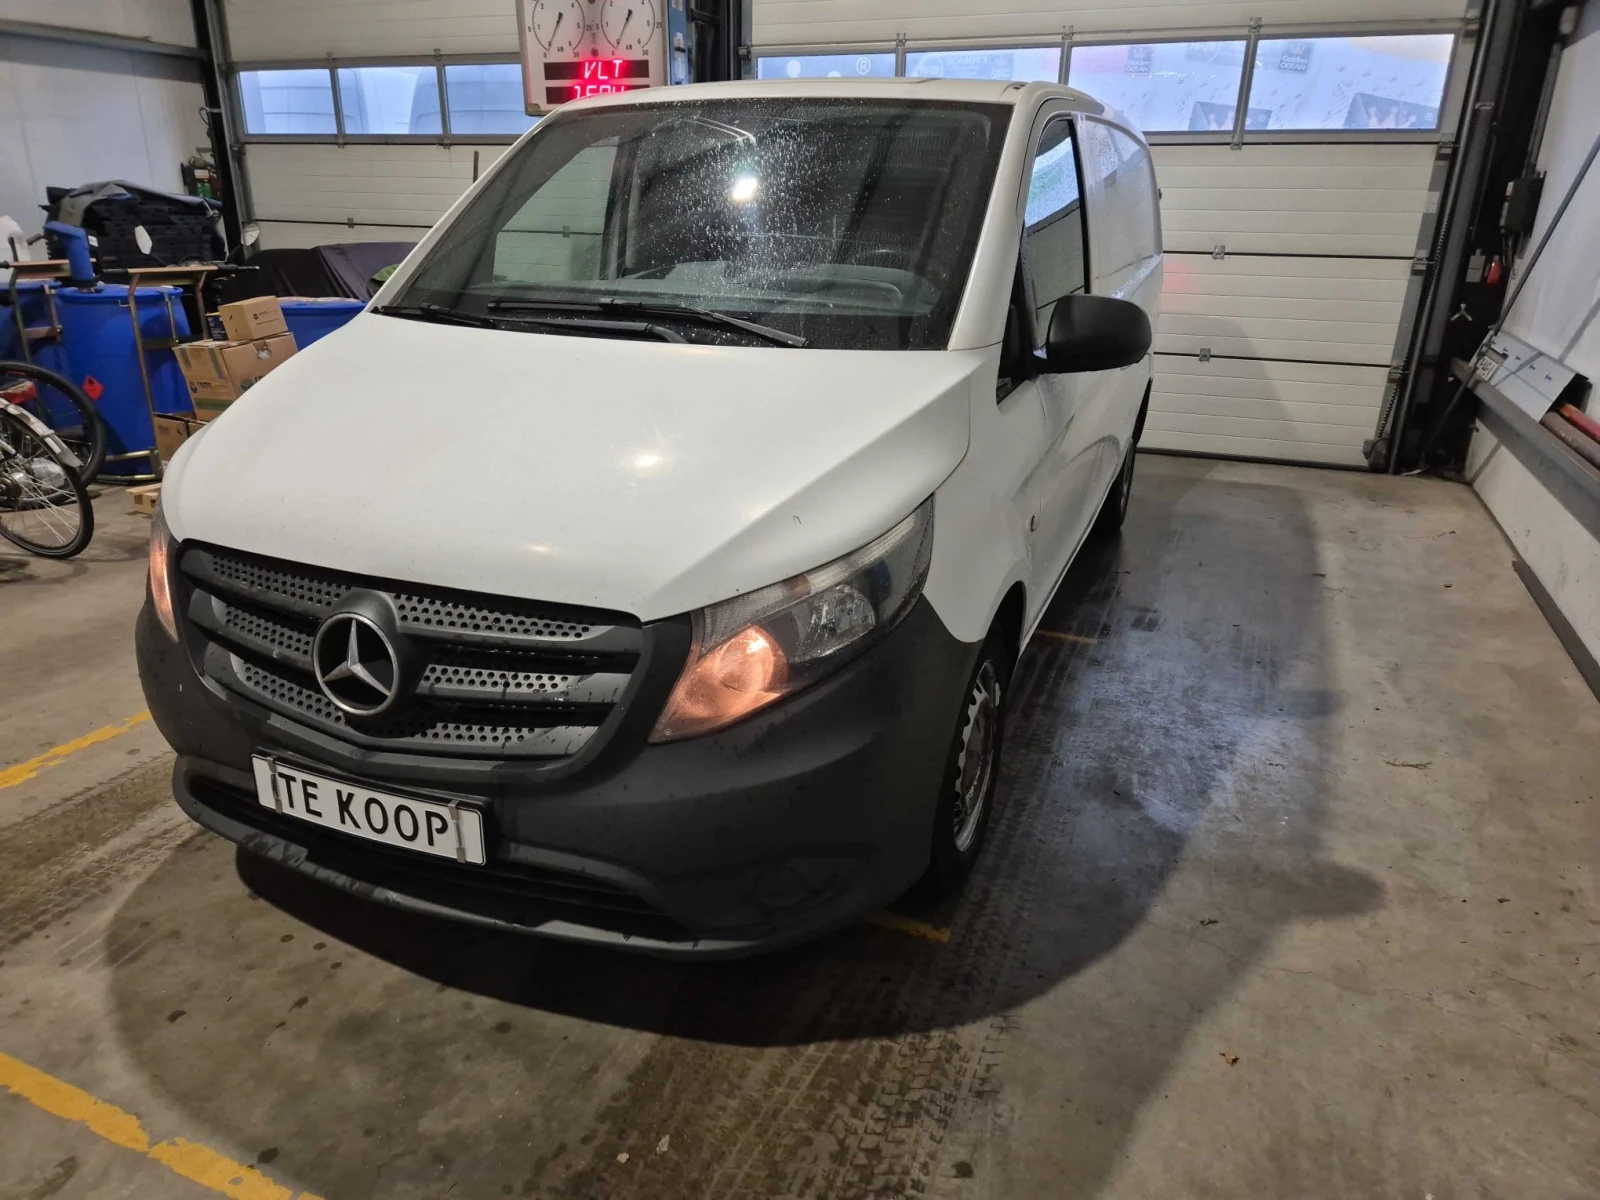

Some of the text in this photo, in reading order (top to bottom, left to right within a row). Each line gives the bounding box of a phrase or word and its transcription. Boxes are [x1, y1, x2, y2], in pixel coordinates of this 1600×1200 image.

[646, 19, 651, 27] 5
[655, 21, 663, 29] 25
[1282, 54, 1308, 65] Golden
[583, 59, 624, 80] VLT
[1280, 61, 1306, 70] OCEAN
[277, 771, 449, 848] TE KOOP
